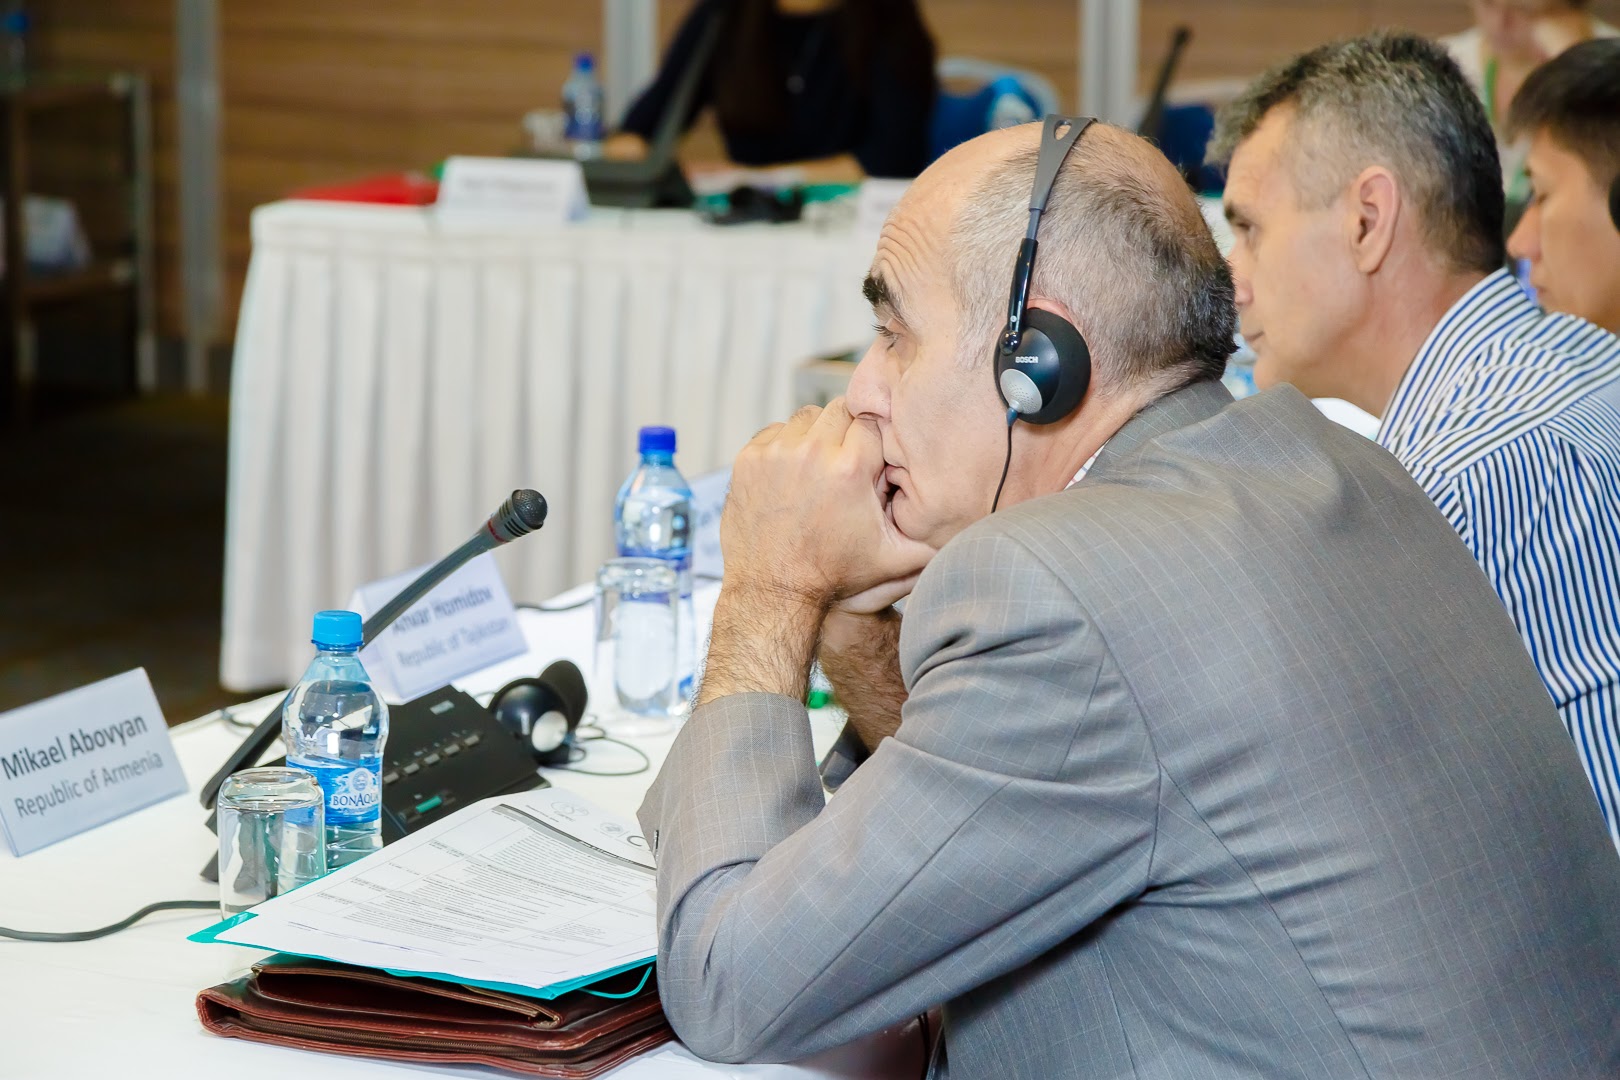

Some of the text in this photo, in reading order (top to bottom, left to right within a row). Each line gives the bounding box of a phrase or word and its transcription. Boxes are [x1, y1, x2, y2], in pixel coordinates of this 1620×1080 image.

[1015, 356, 1039, 364] BOSCH
[1, 715, 149, 781] Mikael Abovyan
[14, 750, 164, 819] Republic of Armenia
